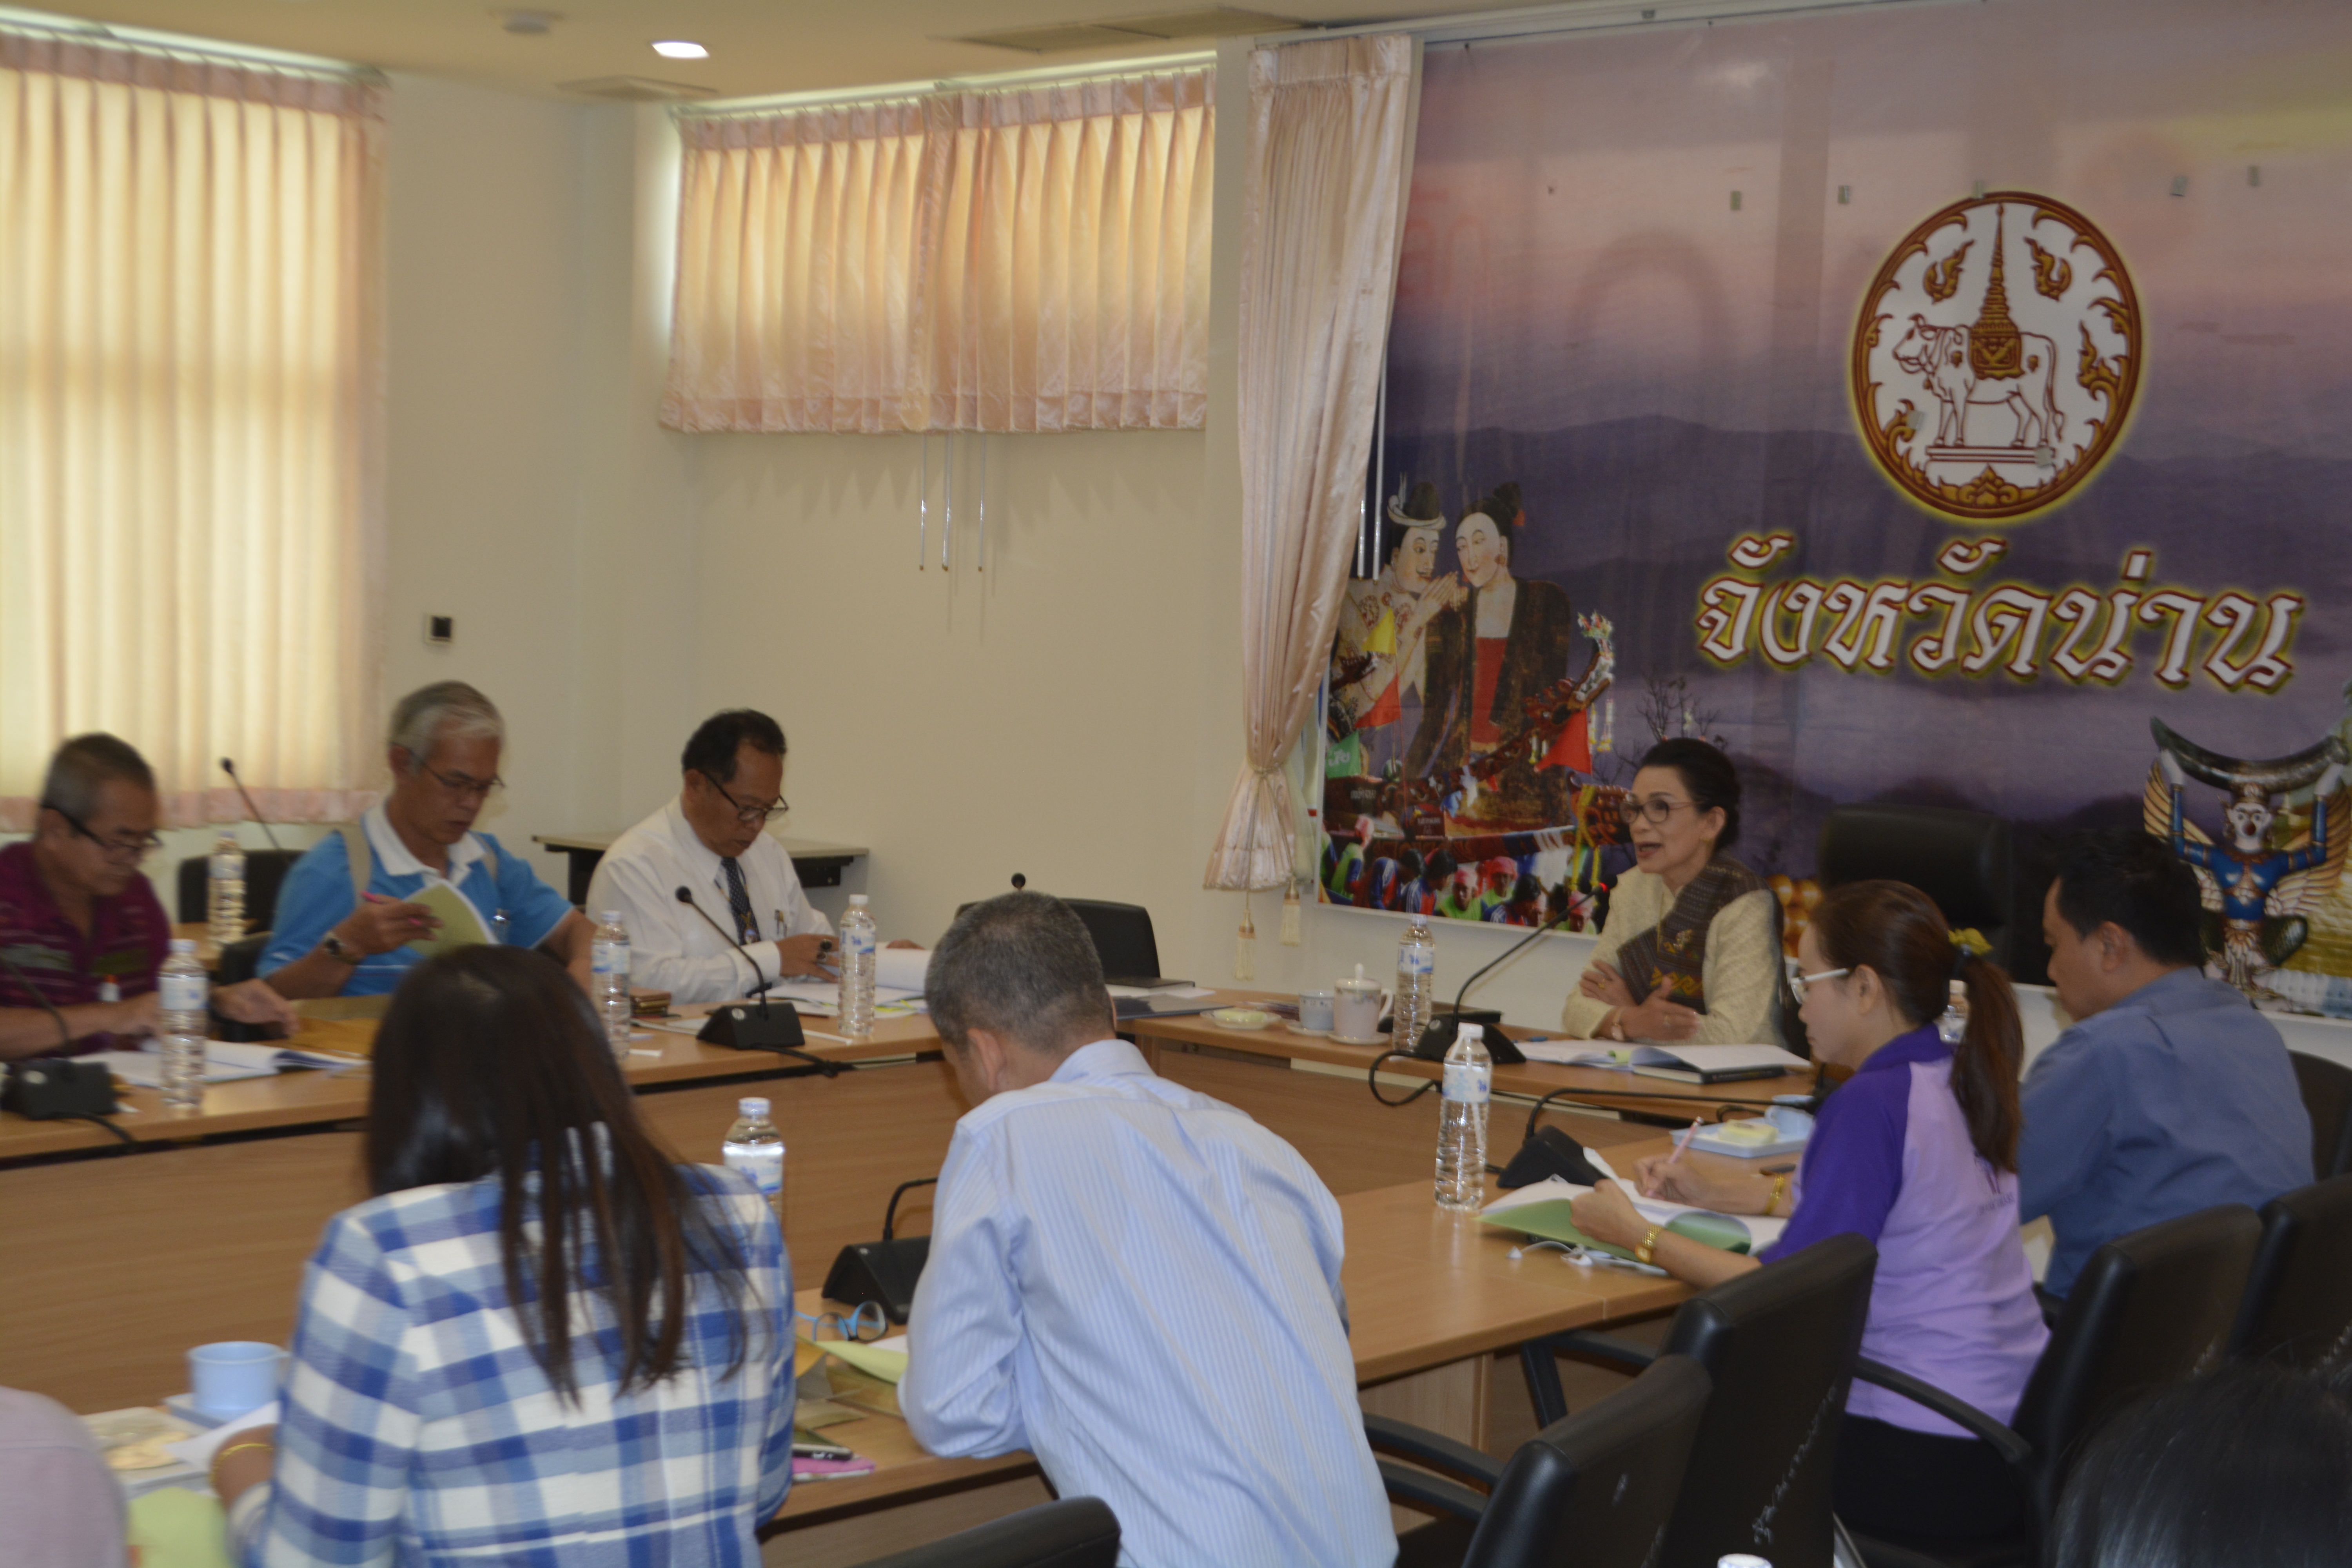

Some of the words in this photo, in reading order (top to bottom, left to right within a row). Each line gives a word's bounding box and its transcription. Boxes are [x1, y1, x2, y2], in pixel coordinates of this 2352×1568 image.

[1698, 535, 2305, 691] จังหวัดน่าน
